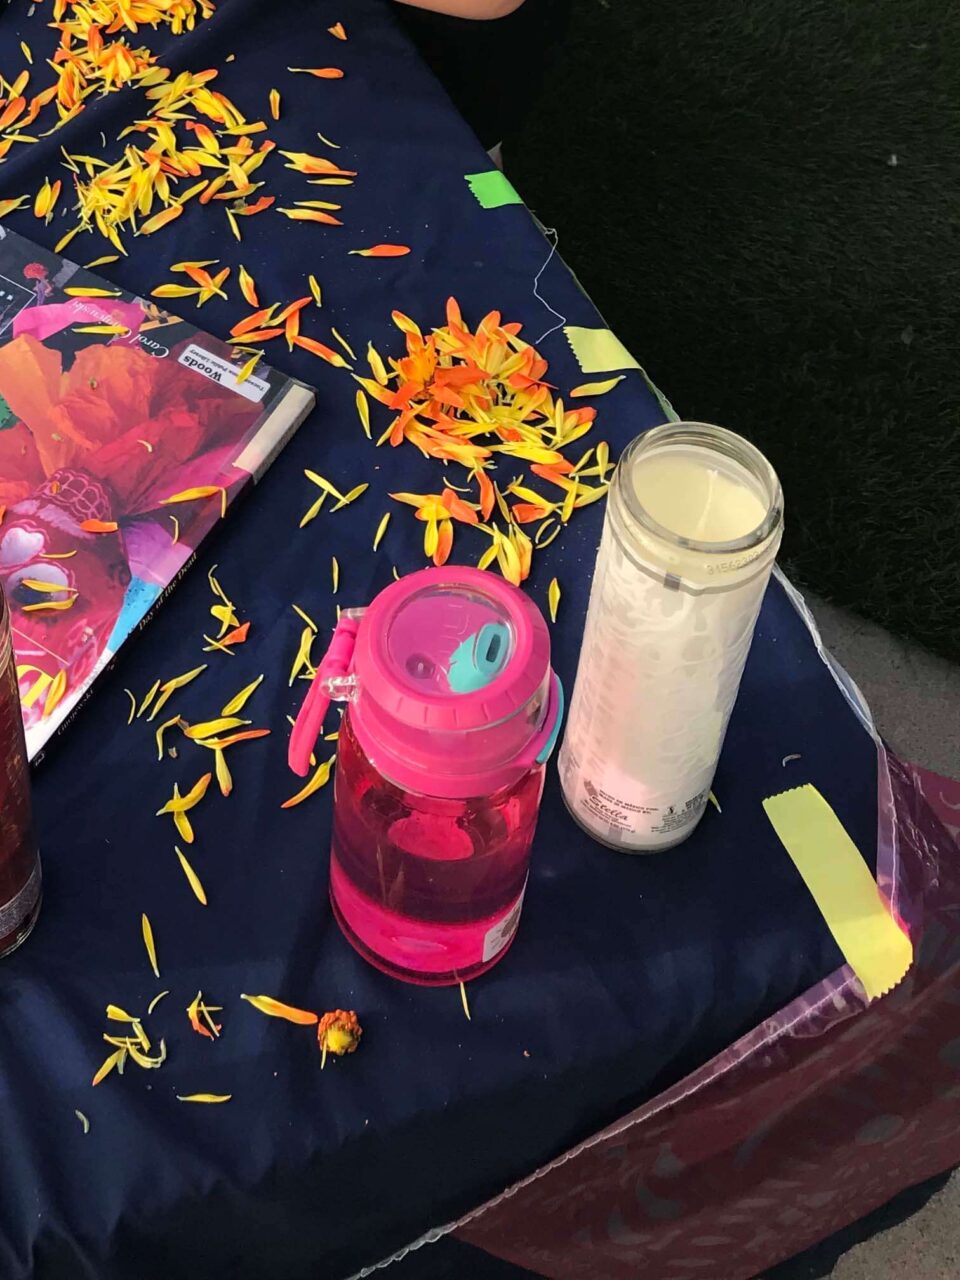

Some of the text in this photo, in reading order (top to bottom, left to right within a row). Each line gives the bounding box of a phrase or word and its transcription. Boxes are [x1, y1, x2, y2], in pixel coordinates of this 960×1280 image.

[128, 333, 169, 358] Carol
[183, 355, 223, 382] Woods
[177, 552, 197, 580] Dead
[589, 795, 628, 821] Stella
